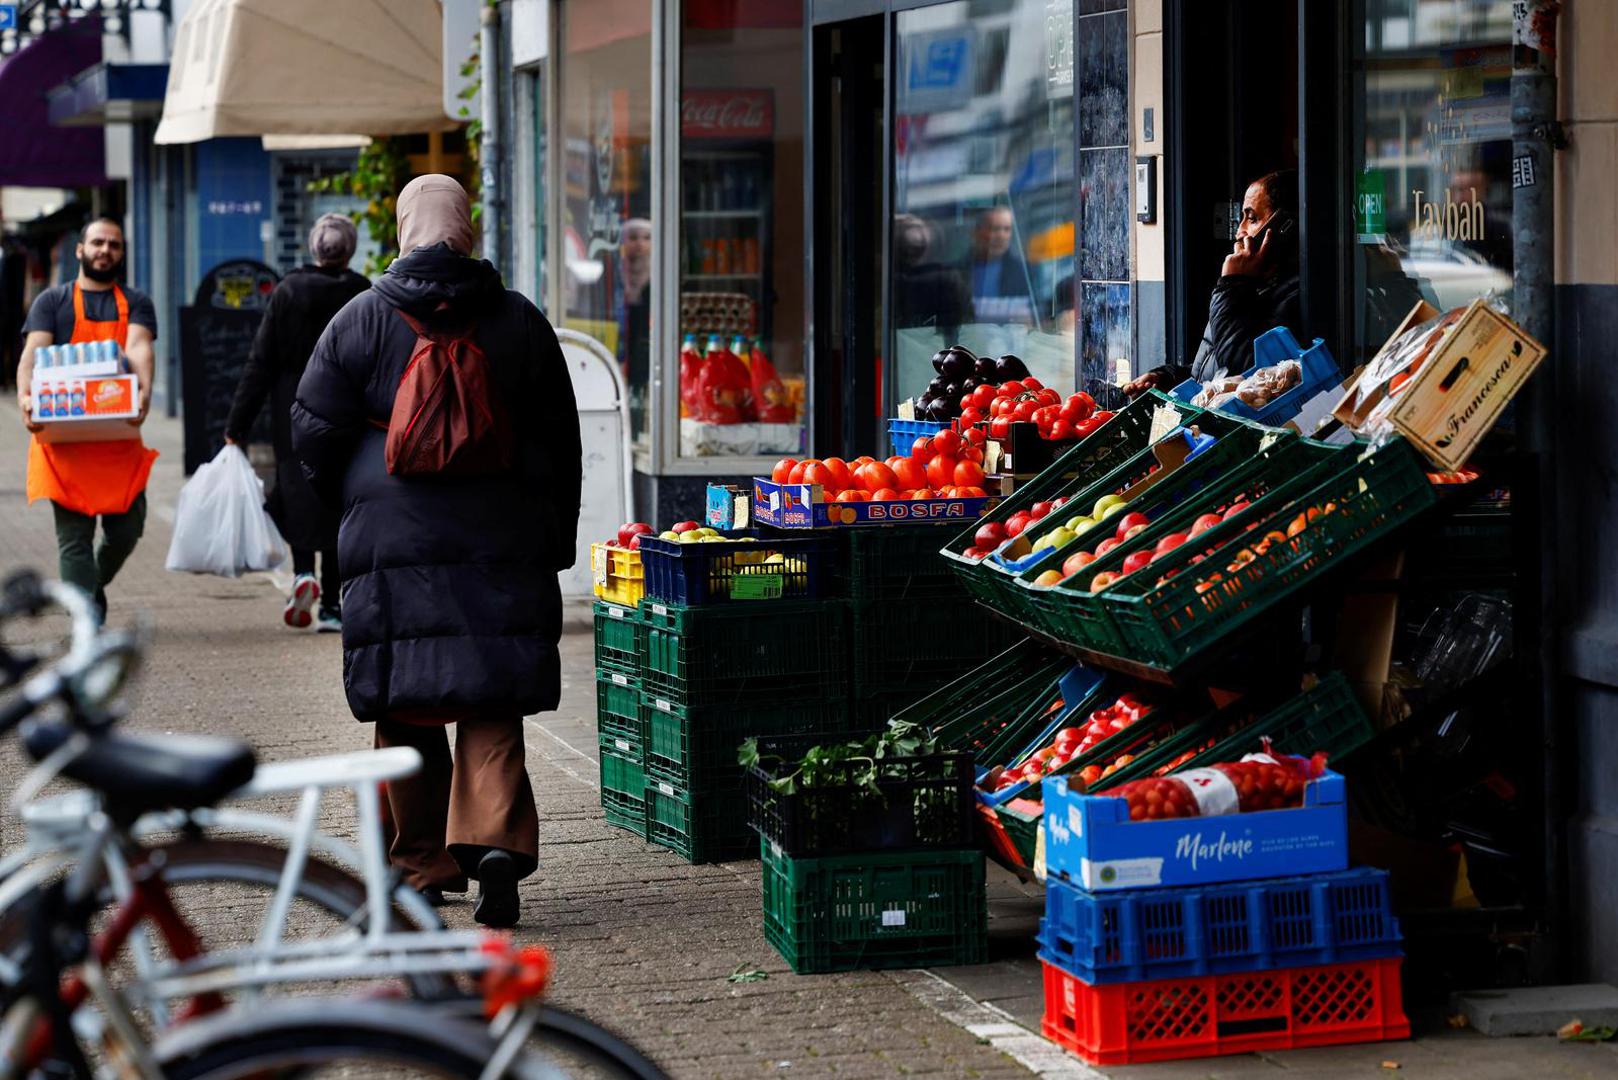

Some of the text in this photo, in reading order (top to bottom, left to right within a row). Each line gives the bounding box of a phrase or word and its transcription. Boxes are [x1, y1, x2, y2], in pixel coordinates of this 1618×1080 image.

[1358, 193, 1382, 215] OPEN
[1412, 187, 1485, 246] Taybah
[1447, 355, 1513, 438] Francesca
[868, 502, 964, 519] BOSFA
[1175, 830, 1253, 871] Marlene
